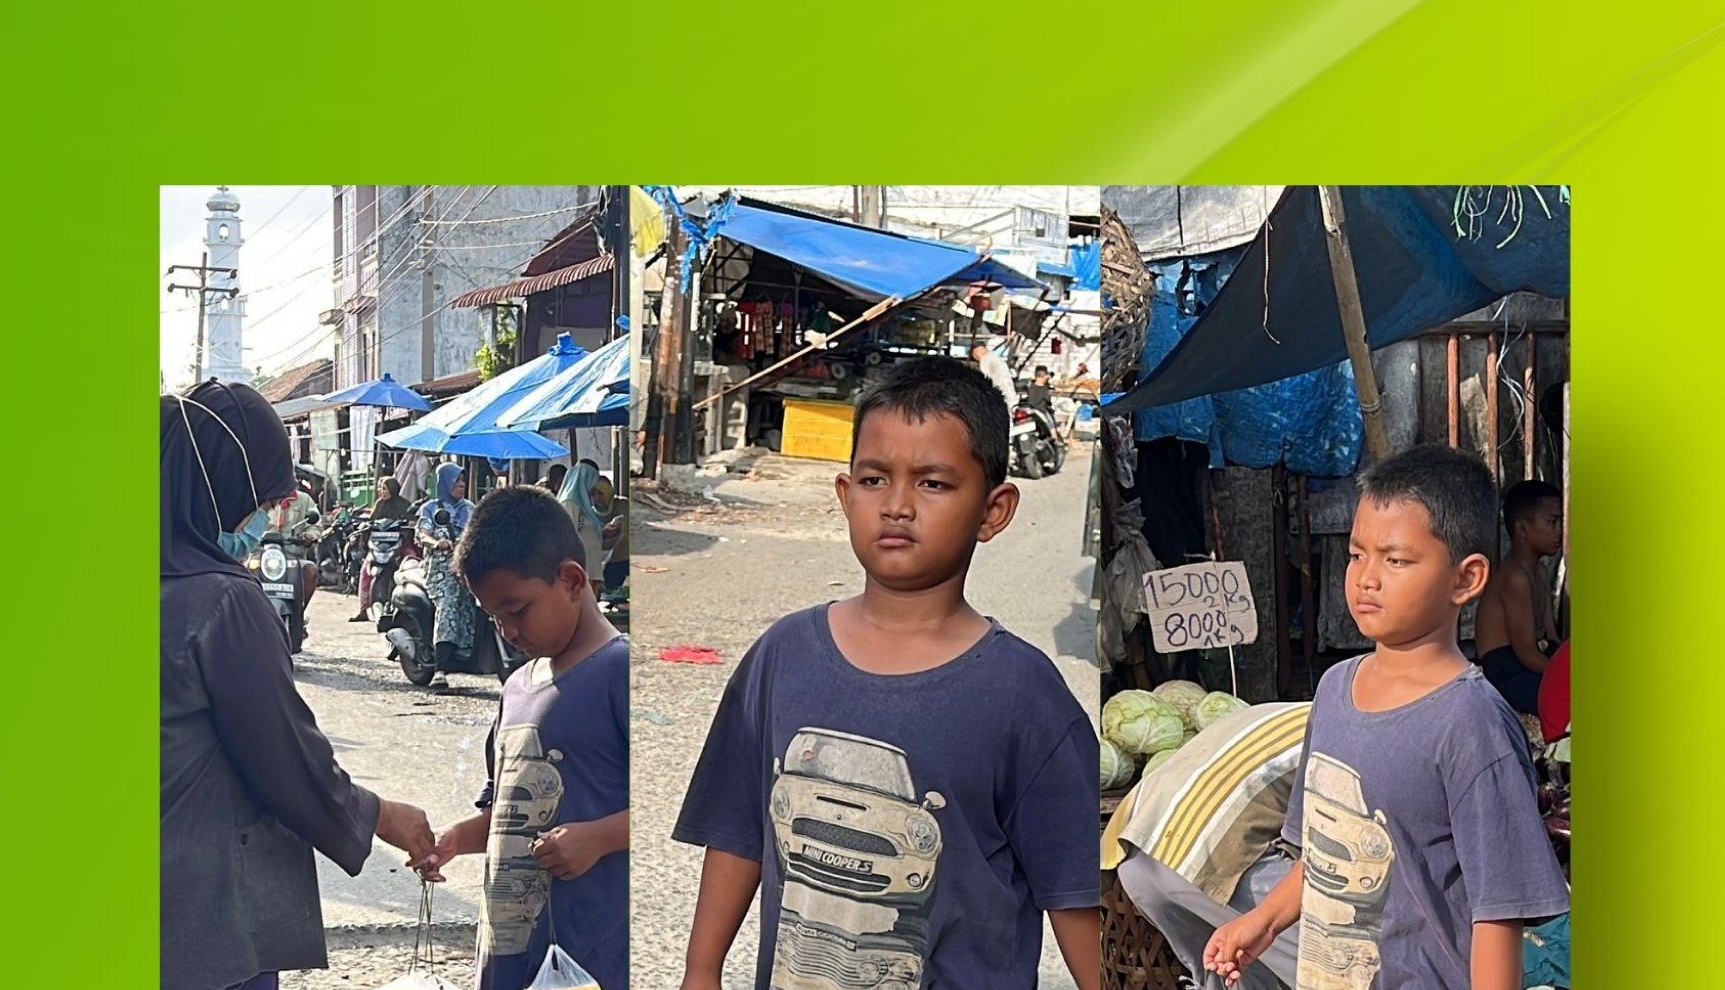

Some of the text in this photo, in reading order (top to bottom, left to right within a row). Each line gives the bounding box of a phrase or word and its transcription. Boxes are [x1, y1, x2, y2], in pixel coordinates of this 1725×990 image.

[1144, 569, 1239, 608] 15000
[1164, 609, 1227, 646] 8000
[803, 845, 872, 872] MINI COOPER S
